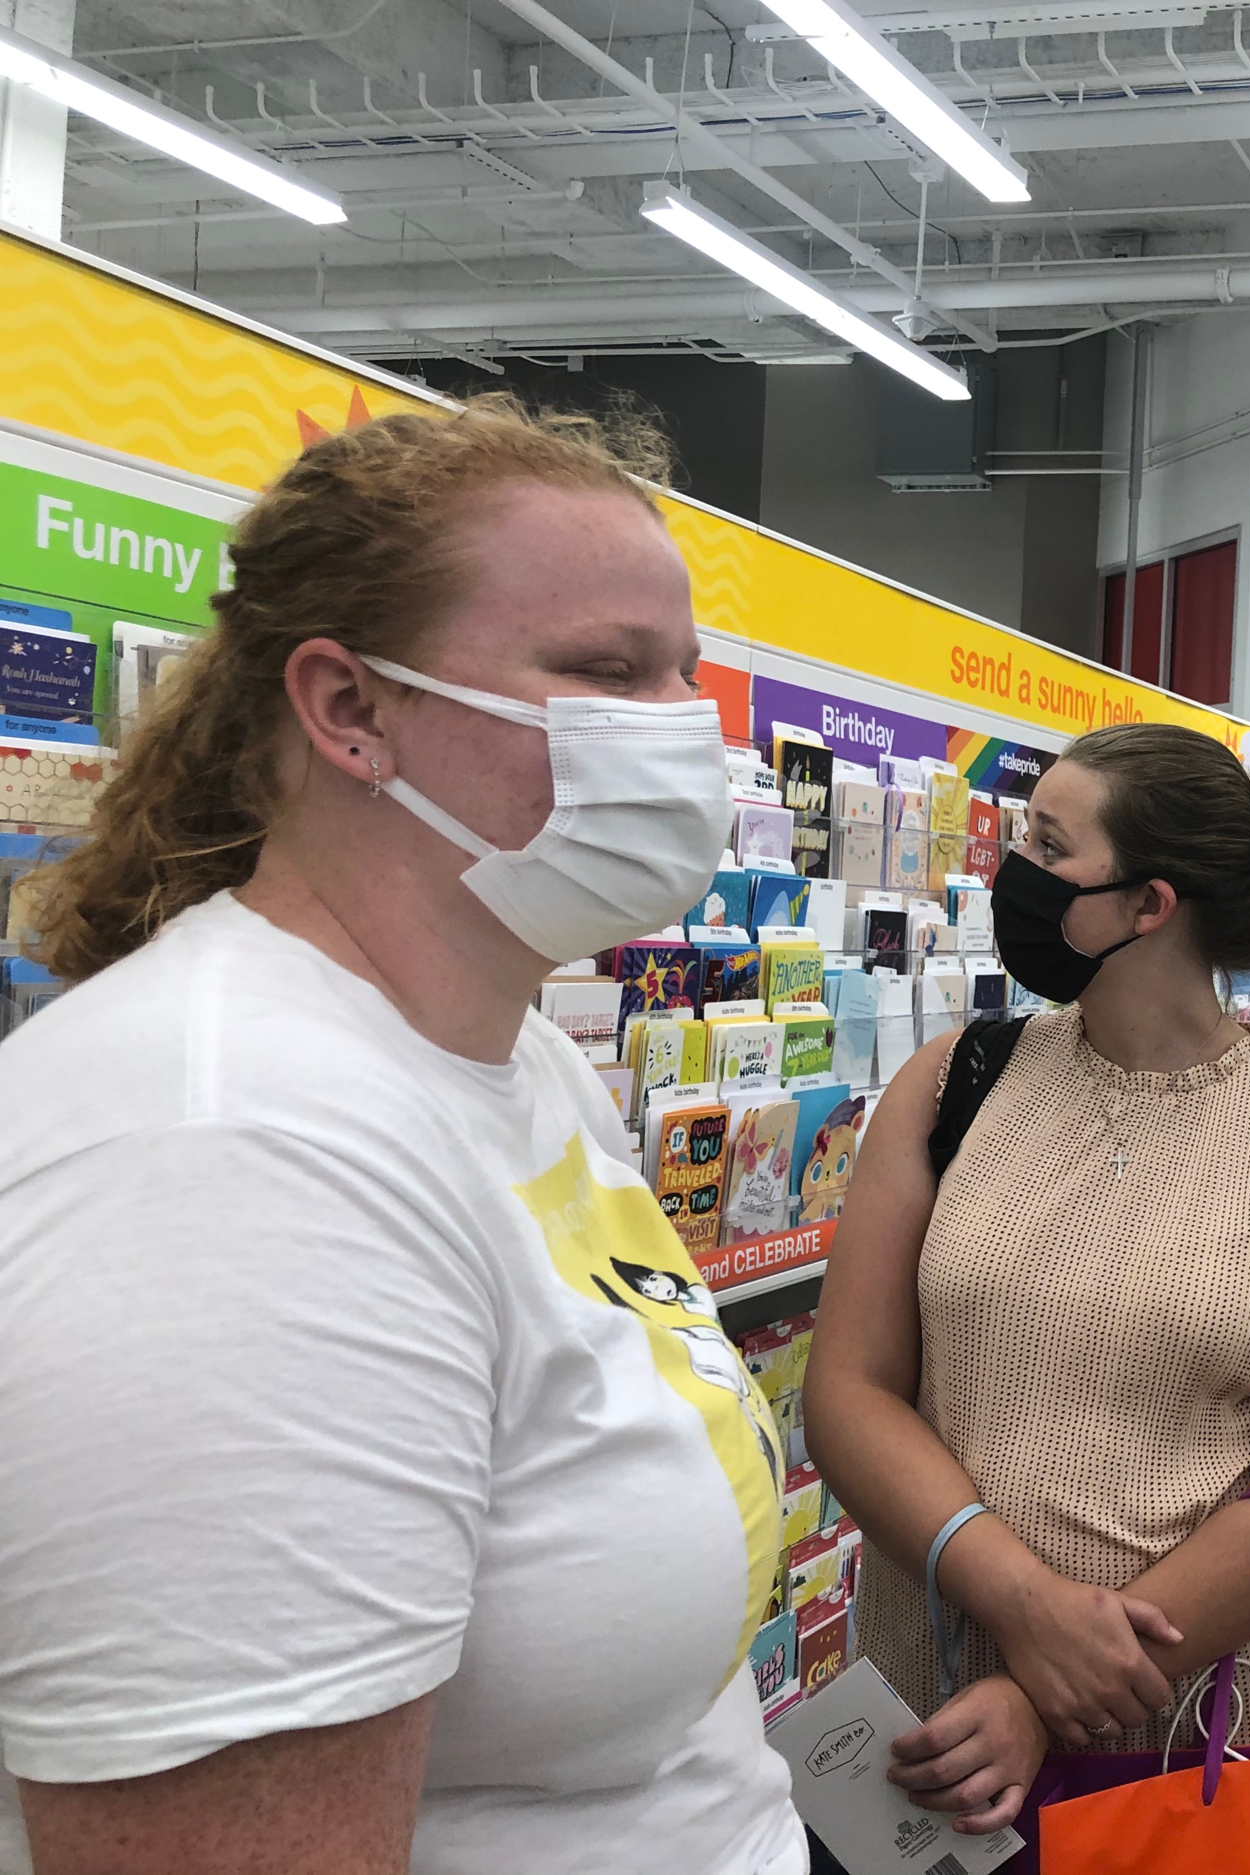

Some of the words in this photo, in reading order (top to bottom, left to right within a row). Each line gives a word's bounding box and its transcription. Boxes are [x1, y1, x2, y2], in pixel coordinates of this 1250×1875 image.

[36, 494, 203, 594] Funny
[950, 645, 1012, 698] send
[1018, 669, 1032, 705] a
[1038, 676, 1097, 731] sunny
[5, 719, 19, 730] for
[21, 723, 57, 735] anyone
[822, 704, 895, 756] Birthday
[998, 752, 1041, 777] #takepride
[785, 779, 828, 812] HAPPY
[977, 815, 991, 836] UR
[646, 970, 660, 999] 5
[771, 959, 821, 996] ANOTHER
[785, 1037, 824, 1062] AWESOME
[672, 1131, 684, 1148] IF
[692, 1118, 724, 1137] FUTURE
[692, 1136, 721, 1161] YOU
[664, 1162, 720, 1188] TRAVELED
[661, 1196, 681, 1213] BACK
[691, 1188, 716, 1210] TIME
[680, 1208, 688, 1219] IN
[689, 1218, 716, 1240] VISIT
[701, 1254, 730, 1283] and
[733, 1229, 821, 1275] CELEBRATE
[807, 1649, 842, 1688] Cake
[813, 1750, 833, 1770] KATE
[830, 1732, 854, 1755] SMITH
[894, 1818, 929, 1847] RECYCLED
